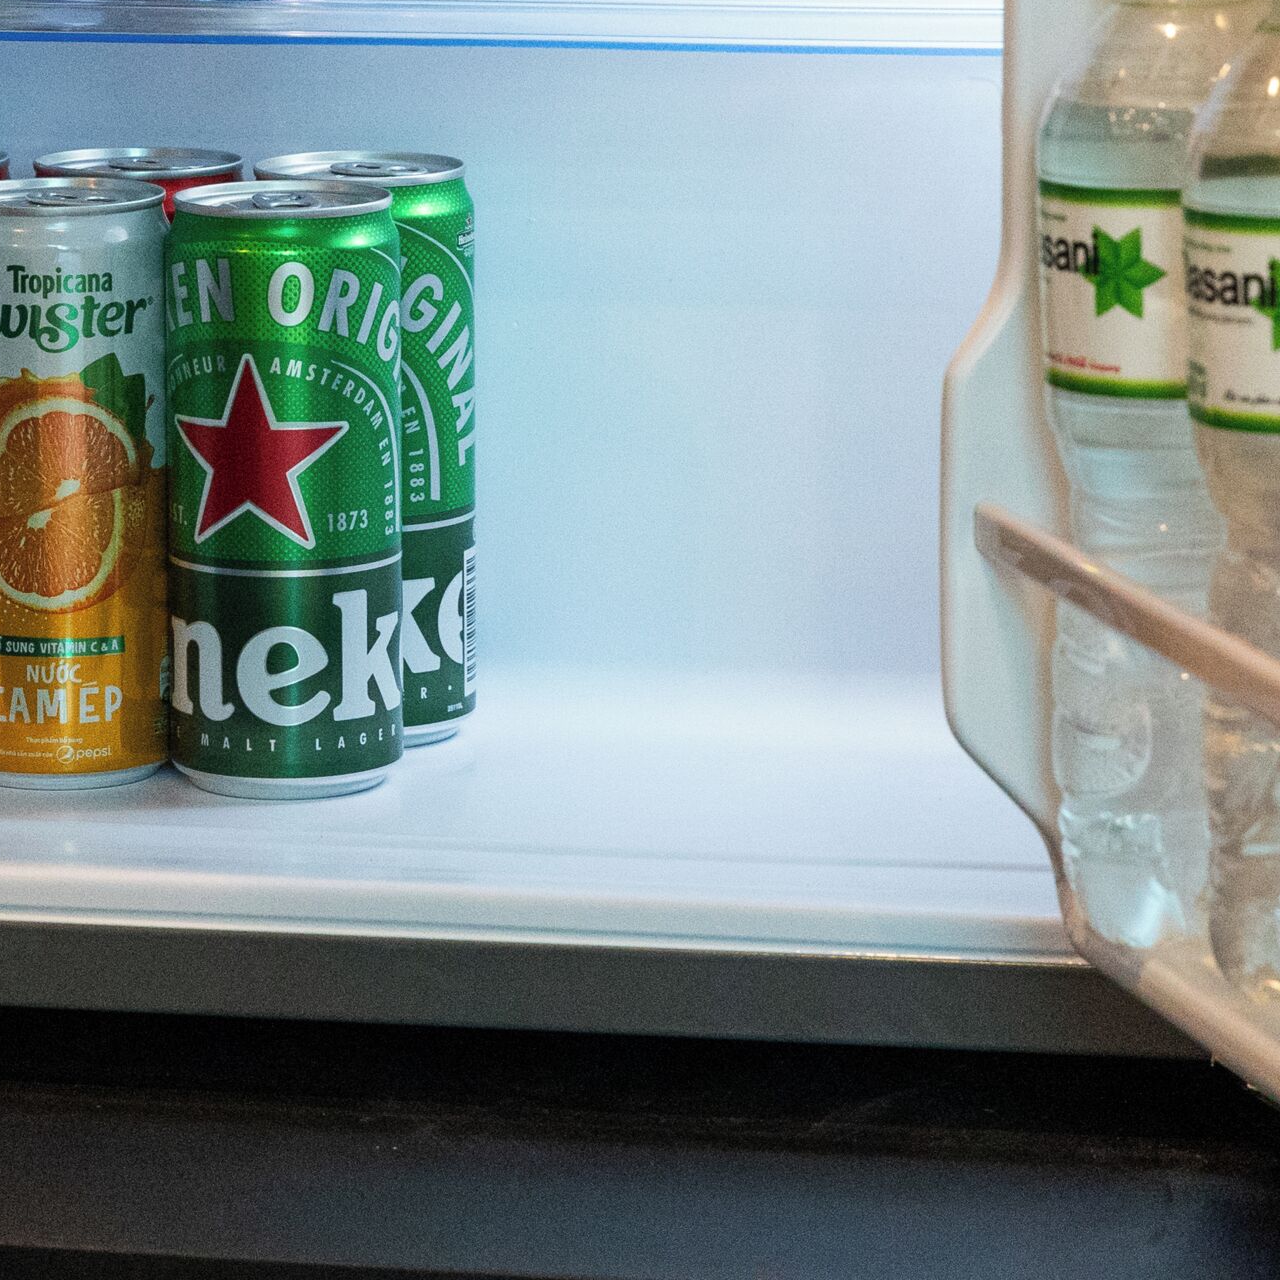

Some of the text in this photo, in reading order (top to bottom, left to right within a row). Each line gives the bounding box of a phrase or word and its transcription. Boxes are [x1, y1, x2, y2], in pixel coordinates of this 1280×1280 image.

[7, 265, 113, 299] Tropicana
[269, 356, 383, 430] AMSTERDAM
[378, 437, 392, 466] EN
[408, 448, 426, 503] 1883
[327, 509, 370, 533] 1873
[383, 479, 395, 536] 1883
[5, 641, 35, 653] SUNG
[40, 641, 86, 654] VITAMIN
[90, 642, 98, 652] C
[111, 638, 119, 651] A
[79, 681, 123, 724] ÉP
[75, 745, 113, 760] pepsi
[201, 732, 277, 752] MALT
[315, 723, 398, 752] LAGER
